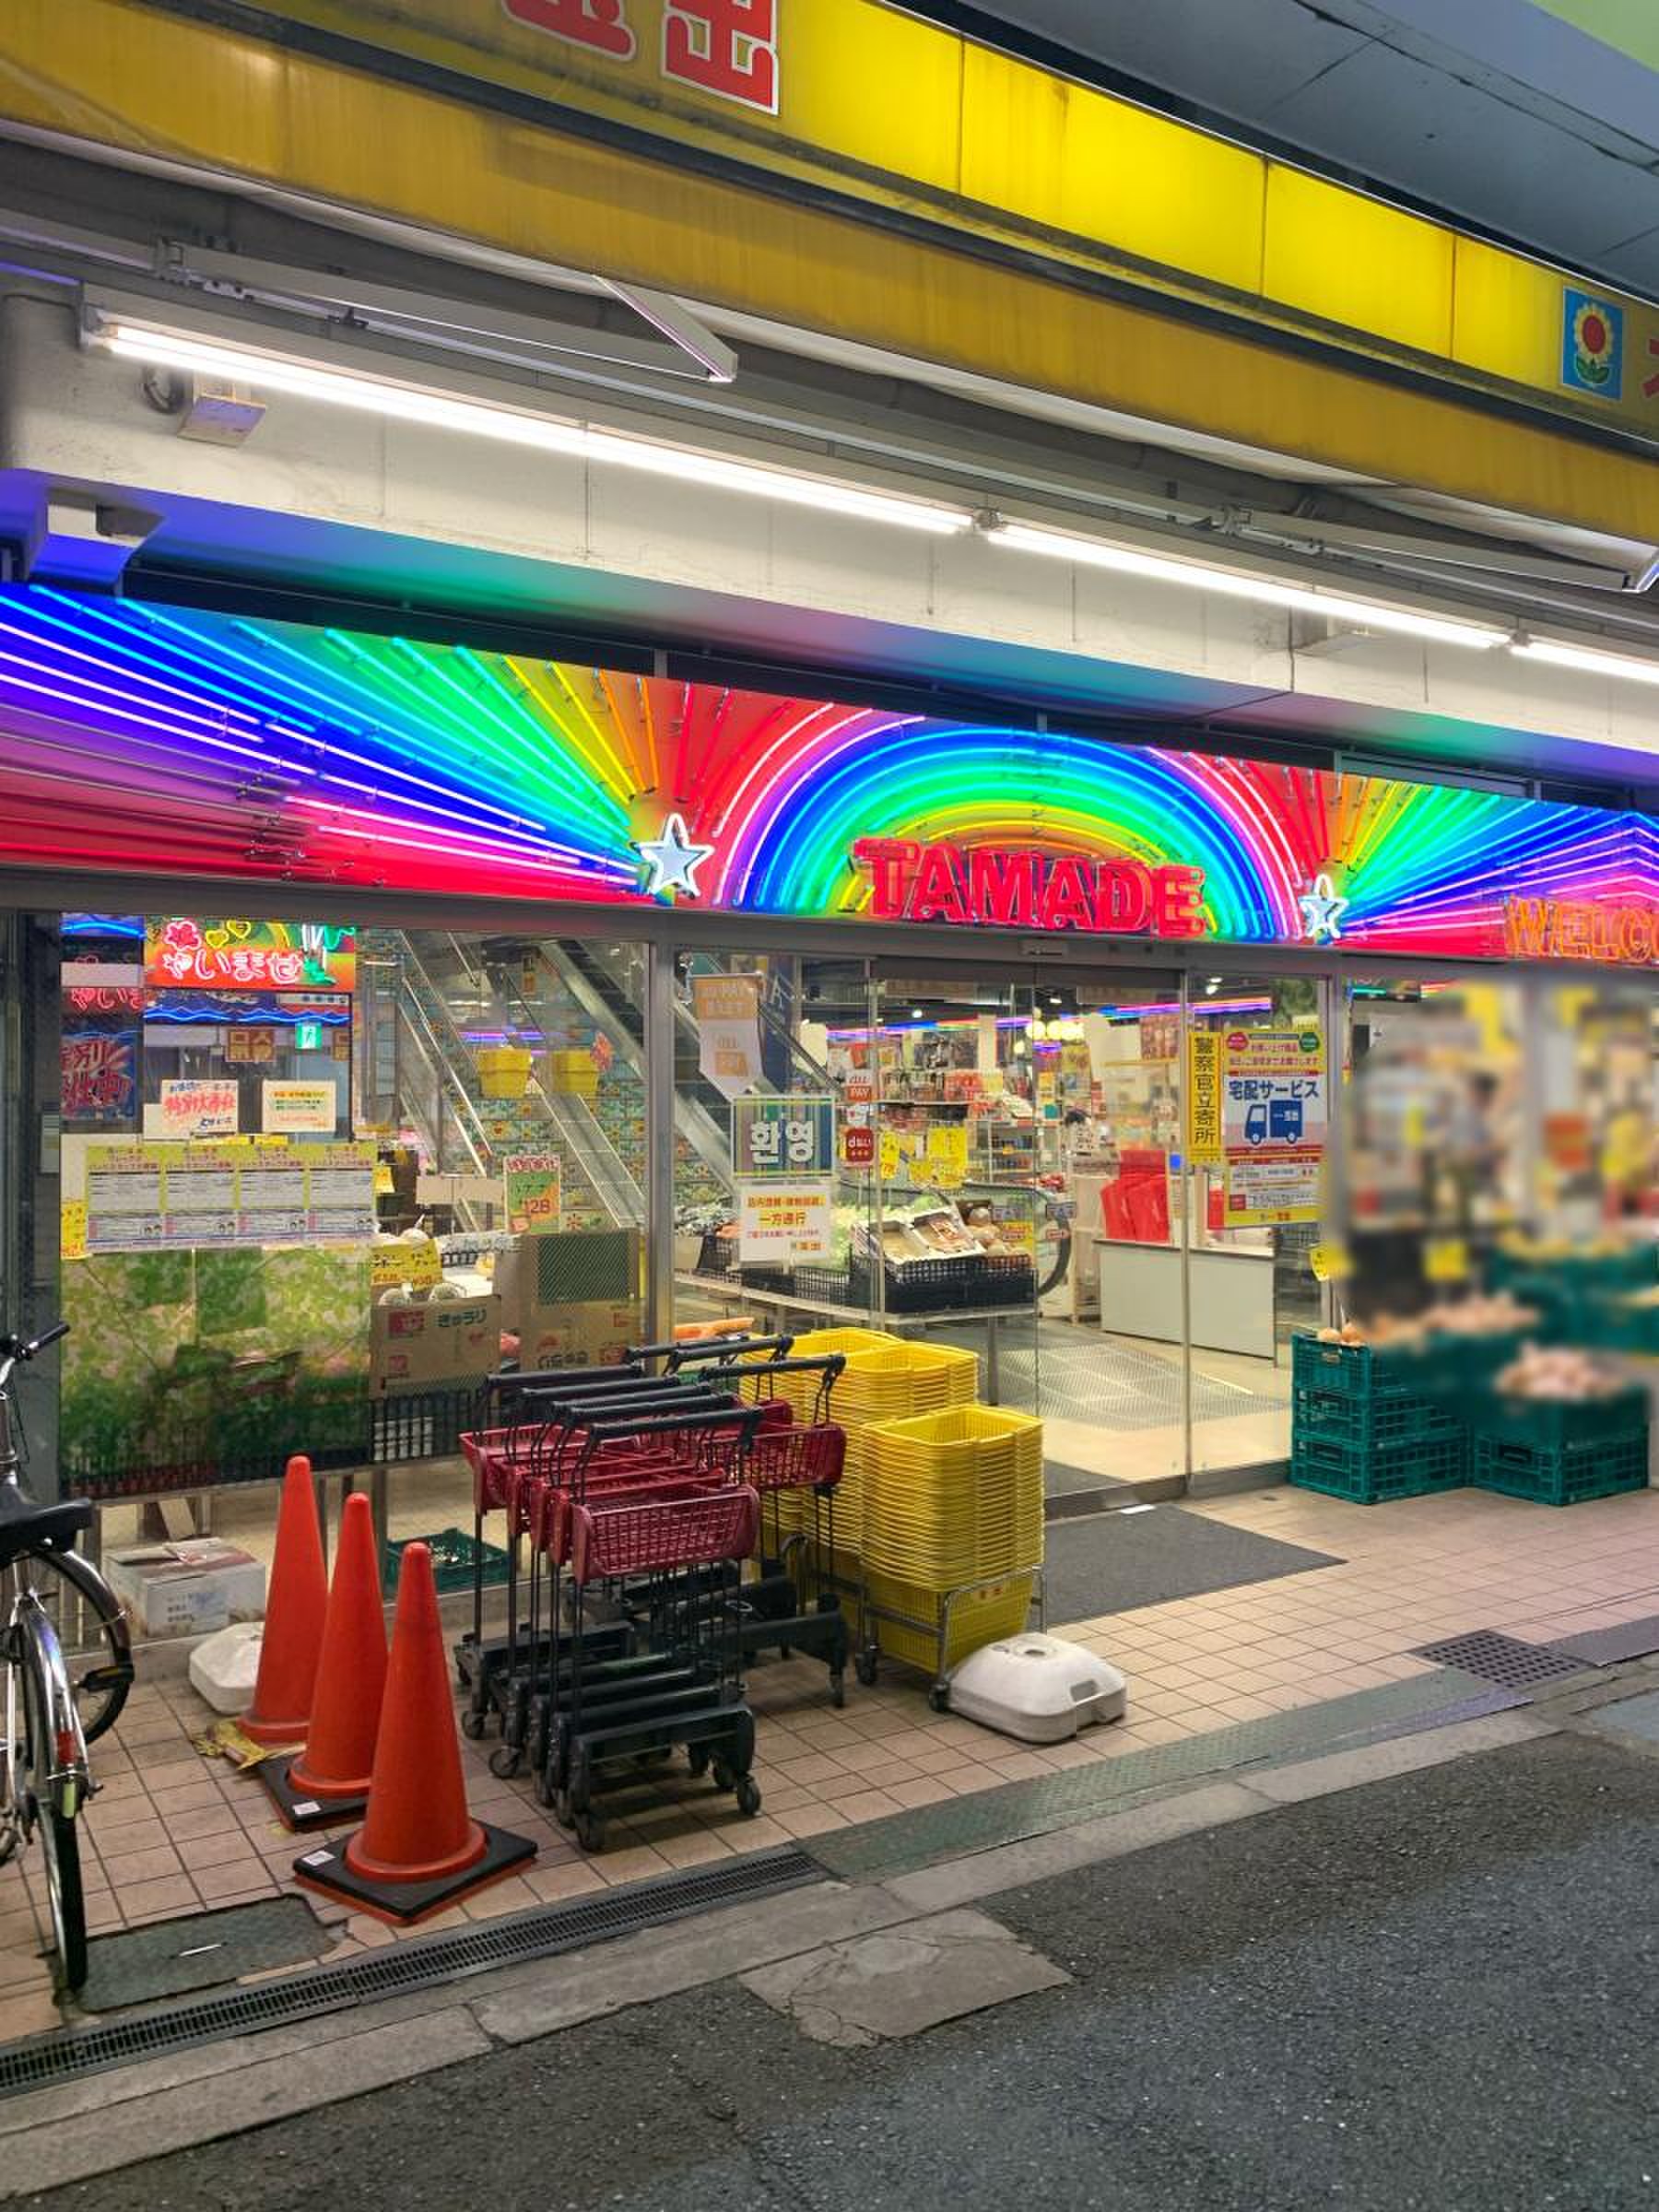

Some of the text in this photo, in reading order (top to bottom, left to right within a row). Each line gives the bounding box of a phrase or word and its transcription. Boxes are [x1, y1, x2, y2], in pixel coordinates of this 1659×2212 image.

[853, 837, 1206, 938] TAMADE
[1504, 894, 1659, 963] WELC
[1194, 1037, 1216, 1145] 警察官立寄所
[1229, 1079, 1320, 1101] 宅配サービス
[749, 1120, 815, 1166] 환영
